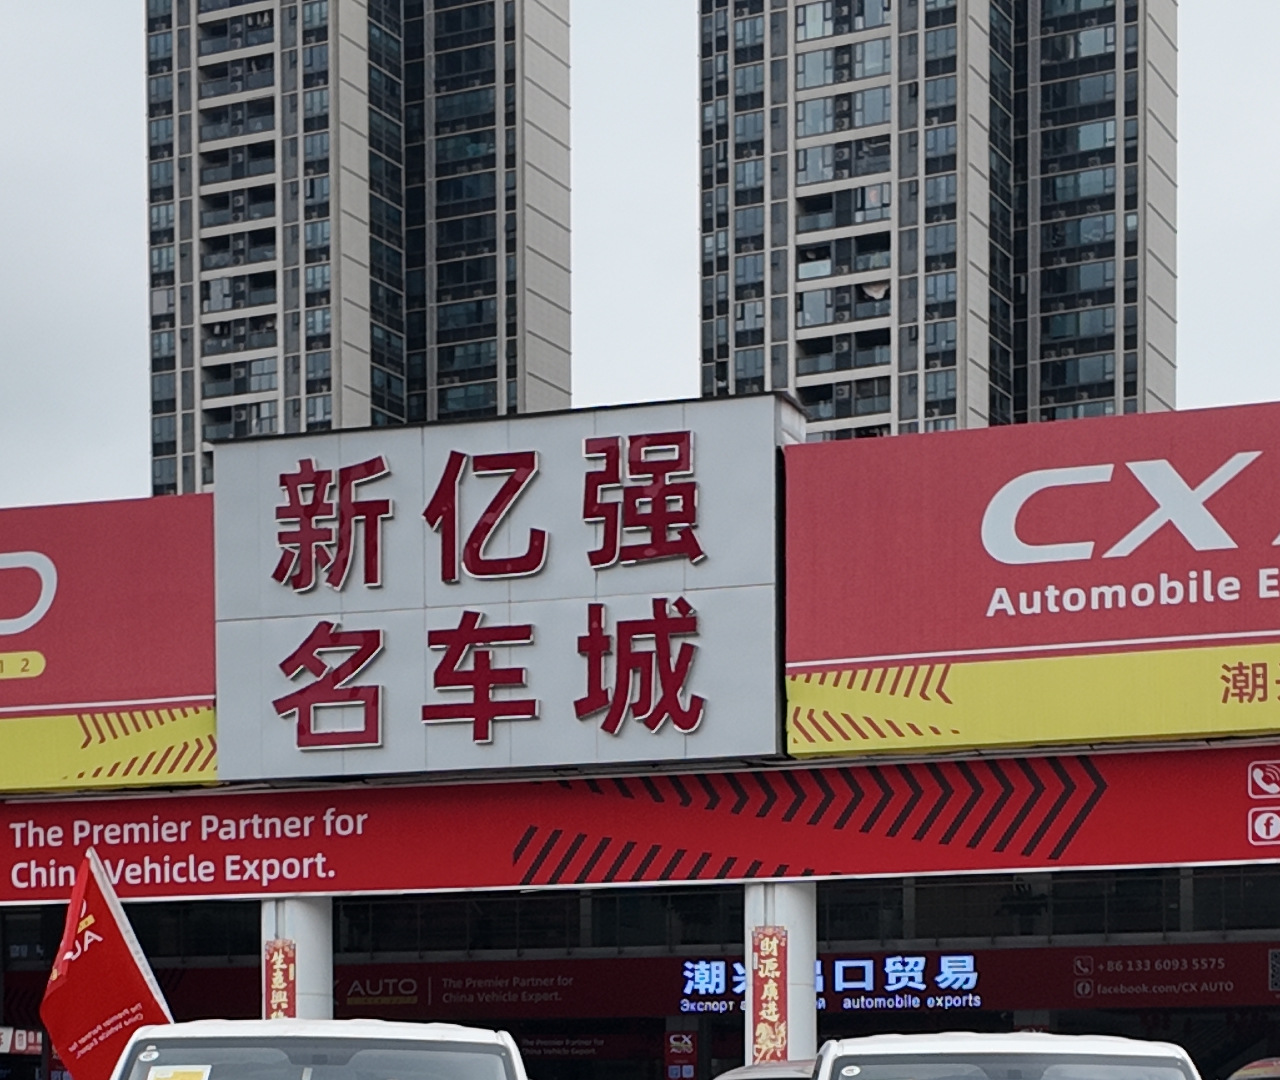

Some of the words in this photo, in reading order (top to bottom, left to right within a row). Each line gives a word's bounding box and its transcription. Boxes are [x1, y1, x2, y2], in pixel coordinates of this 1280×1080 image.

[271, 430, 707, 593] 新亿强
[981, 450, 1263, 564] CX
[986, 568, 1240, 618] Automobile
[272, 596, 707, 751] 名车城
[9, 820, 64, 848] The
[73, 814, 191, 846] Premier
[200, 811, 315, 841] Partner
[323, 807, 368, 836] for
[10, 857, 96, 888] Chin
[103, 851, 215, 886] Vehicle
[224, 851, 336, 887] Export.
[682, 955, 979, 995] 潮口贸易
[1097, 961, 1123, 971] +86
[1127, 960, 1151, 971] 133
[1154, 959, 1188, 970] 6093
[1191, 958, 1225, 969] 5575
[347, 978, 417, 996] AUTO
[442, 977, 463, 988] The
[465, 977, 510, 988] Premier
[513, 976, 554, 987] Partner
[557, 975, 574, 986] for
[1200, 981, 1234, 992] AUTO
[442, 993, 474, 1003] China
[477, 992, 519, 1003] Vehicle
[680, 999, 735, 1014] Экспорт
[843, 994, 920, 1009] automobile
[927, 993, 982, 1010] exports
